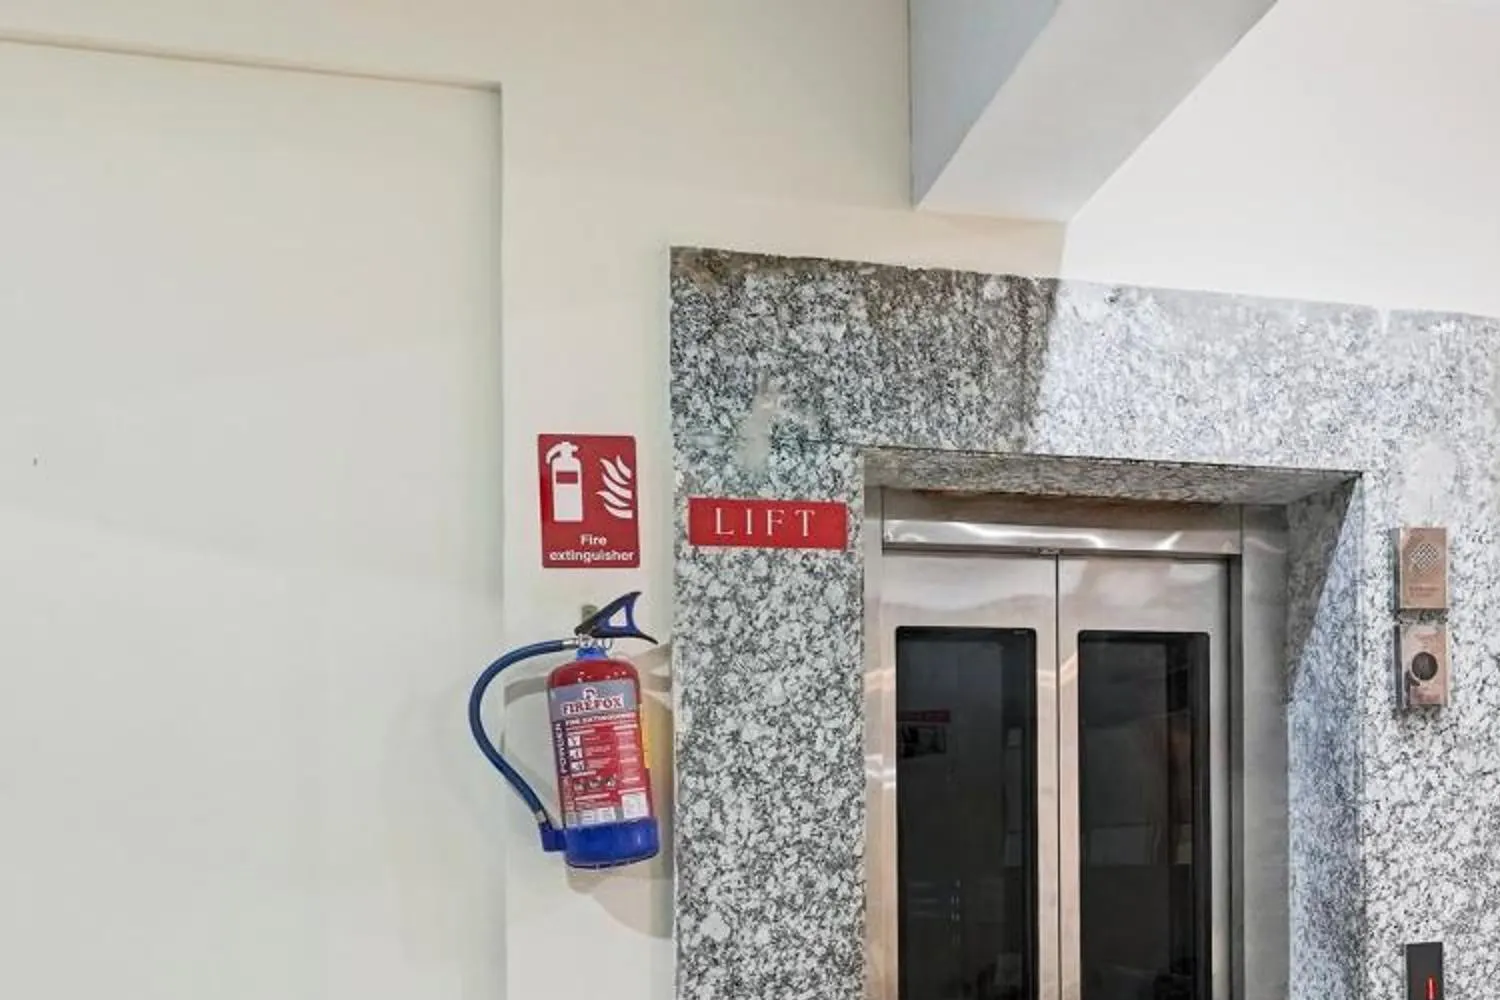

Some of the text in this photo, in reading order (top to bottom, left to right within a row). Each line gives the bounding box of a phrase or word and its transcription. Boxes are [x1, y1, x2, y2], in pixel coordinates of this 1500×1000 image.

[715, 507, 816, 537] LIFT
[580, 534, 607, 546] Fire
[549, 549, 634, 564] extinguisher
[562, 694, 624, 716] FIREFOX
